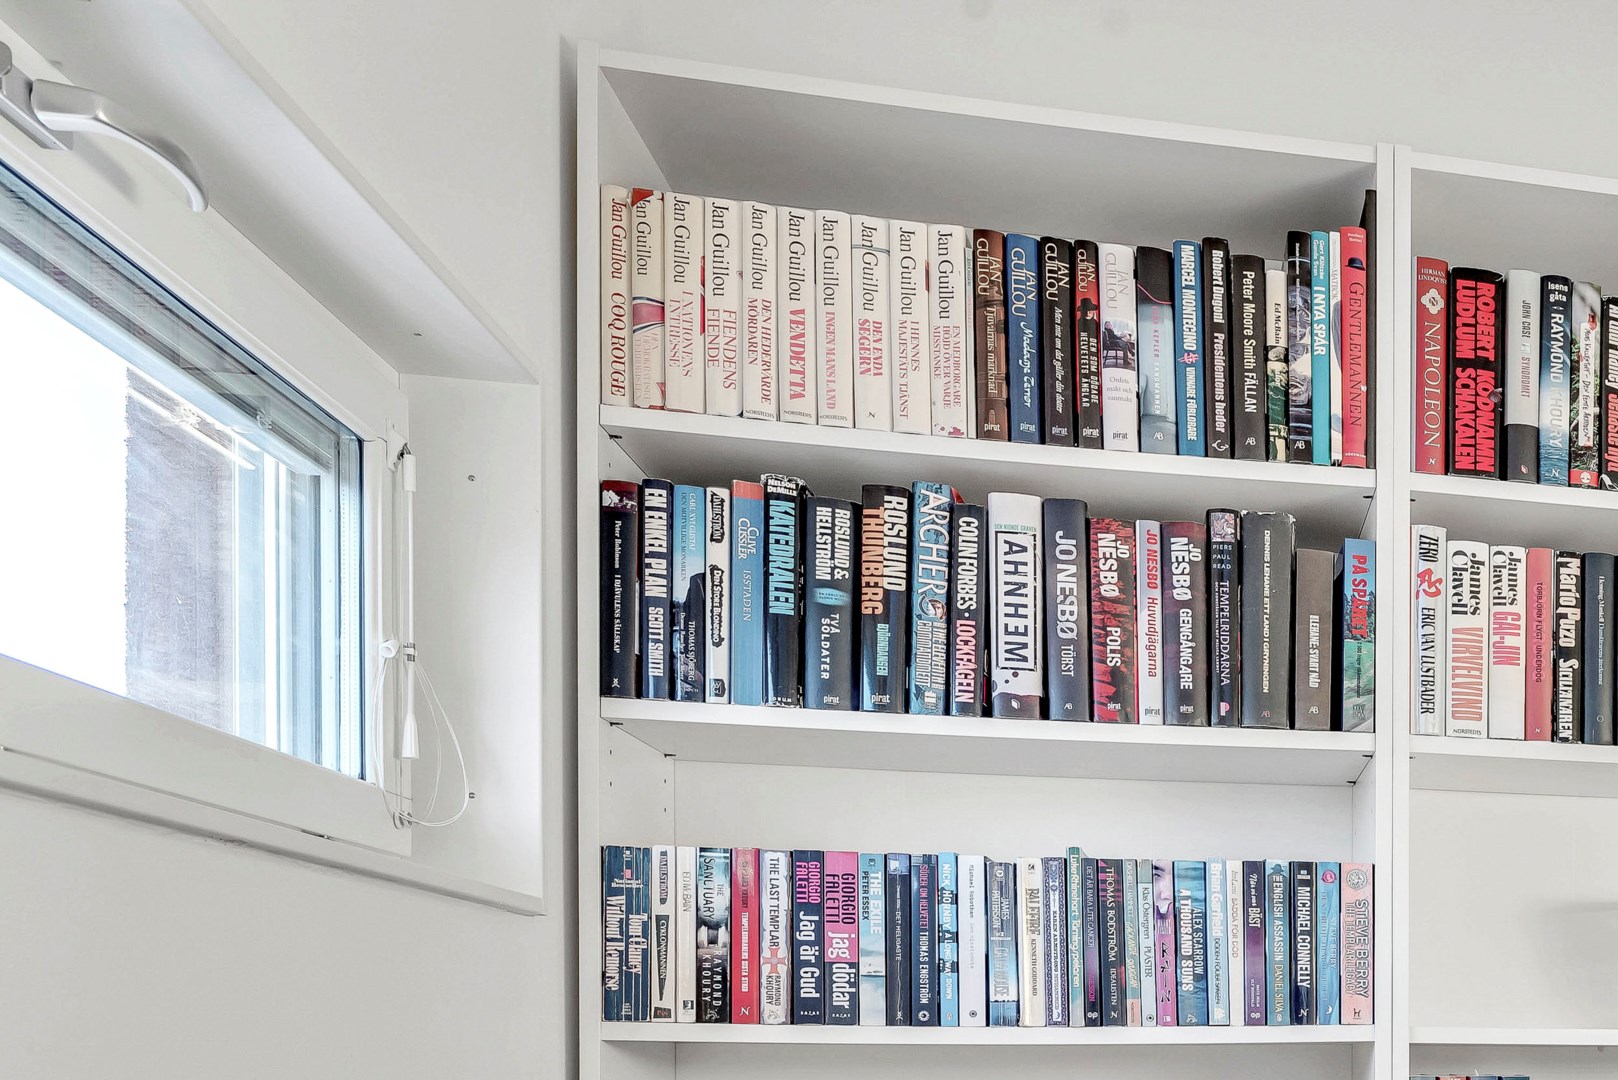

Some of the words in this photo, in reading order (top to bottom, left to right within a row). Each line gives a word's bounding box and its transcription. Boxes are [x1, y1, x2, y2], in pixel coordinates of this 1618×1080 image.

[611, 198, 628, 221] Jan
[788, 211, 806, 238] Jan
[611, 224, 628, 280] Guillou
[788, 241, 806, 302] Guillou
[1180, 245, 1194, 286] MARCEL
[1211, 250, 1224, 284] Robert
[1010, 248, 1026, 317] GUILLOU
[1025, 271, 1037, 301] JAN
[1212, 286, 1225, 324] Dugoni
[1242, 271, 1255, 295] Peter
[608, 292, 627, 331] COQ
[1182, 288, 1197, 351] MONTECINO
[1243, 300, 1256, 328] Moore
[1313, 300, 1326, 325] NYA
[1456, 279, 1474, 359] LUDLUM
[1476, 283, 1496, 361] ROBERT
[707, 308, 720, 368] FIENDE
[722, 309, 737, 391] FIENDENS
[789, 308, 807, 401] VENDETTA
[1244, 342, 1256, 371] Smith
[1313, 327, 1327, 355] SPÅR
[1348, 281, 1363, 428] GENTLEMANNEN
[610, 332, 626, 398] ROUGE
[1213, 333, 1226, 401] Presidentens
[1423, 322, 1441, 448] NAPOLEON
[1244, 374, 1257, 413] FÄLLAN
[1020, 422, 1036, 433] pirat
[1214, 403, 1226, 434] heder
[1455, 367, 1475, 470] SCHAKALEN
[1476, 369, 1495, 472] KODNAMN
[644, 488, 667, 508] EN
[643, 510, 667, 554] ENKEL
[883, 495, 908, 591] ROSLUND
[918, 489, 949, 595] ARCHER
[958, 516, 979, 555] COLIN
[1054, 530, 1078, 559] JO
[1115, 541, 1131, 558] JO
[644, 558, 668, 598] PLAN
[768, 499, 796, 616] KATEDRALEN
[860, 507, 884, 616] THUNBERG
[1098, 534, 1118, 598] NESBØ
[956, 556, 978, 610] FORBES
[1002, 539, 1031, 663] AHNHEM
[1054, 563, 1078, 639] NESBØ
[1450, 550, 1469, 616] Clavell
[1468, 553, 1486, 616] James
[648, 607, 664, 639] SCOTT
[1145, 597, 1159, 678] Huvudjägarna
[1219, 581, 1231, 686] TEMPELRIDDARNA
[1420, 607, 1436, 631] ERIC
[1492, 611, 1522, 667] GAI-JIN
[649, 643, 664, 677] SMITH
[955, 619, 976, 704] LOCKFÅGELN
[1060, 644, 1075, 677] TÖRST
[1106, 627, 1121, 668] POLIS
[1178, 609, 1193, 690] GENGÅNGARE
[1420, 633, 1436, 653] VAN
[1419, 655, 1436, 715] LUSTBADER
[1451, 627, 1484, 721] VIRVELVIND
[769, 858, 780, 875] THE
[769, 877, 780, 899] LAST
[769, 902, 780, 948] TEMPLAR
[797, 911, 819, 941] Jag
[1179, 900, 1193, 956] THOUSAND
[1296, 887, 1311, 932] MICHAEL
[1353, 899, 1369, 943] STEVE
[799, 945, 819, 963] är
[827, 932, 856, 961] jag
[1296, 935, 1311, 989] CONNELLY
[799, 968, 821, 999] Gud
[831, 963, 856, 1010] dödar
[1181, 960, 1194, 991] SUNS
[1353, 949, 1369, 998] BERRY
